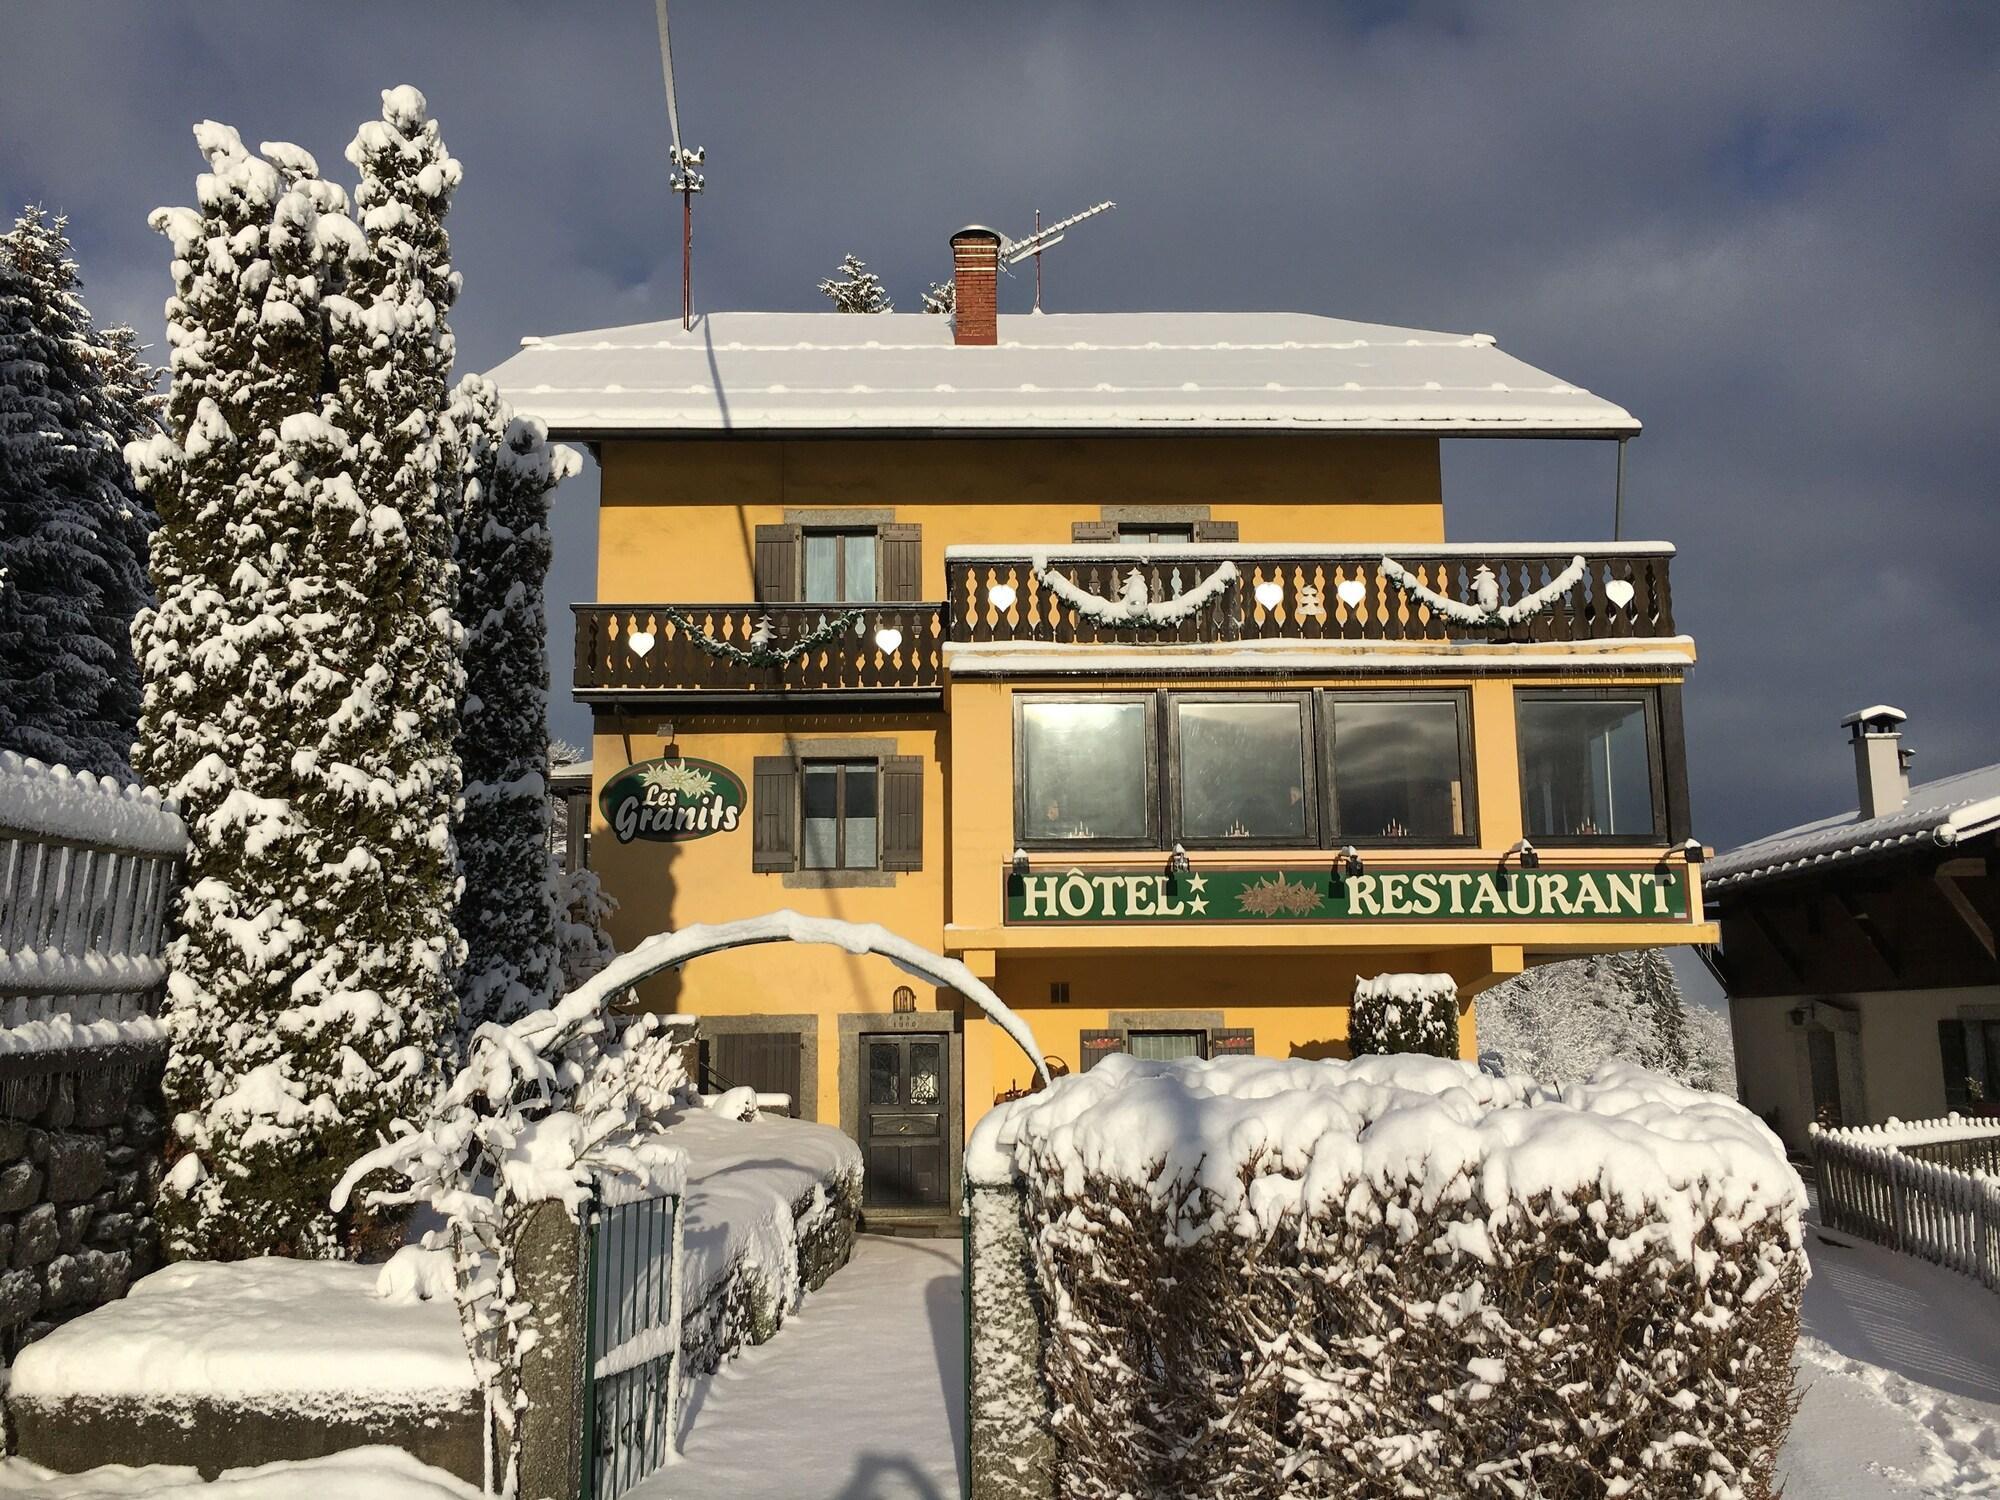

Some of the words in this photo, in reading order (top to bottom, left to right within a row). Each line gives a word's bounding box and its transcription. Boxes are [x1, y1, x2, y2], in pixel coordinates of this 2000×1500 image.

[615, 795, 738, 841] Granits
[642, 785, 677, 806] Les
[1023, 867, 1185, 917] HÔTEL
[1345, 873, 1677, 916] RESTAURANT
